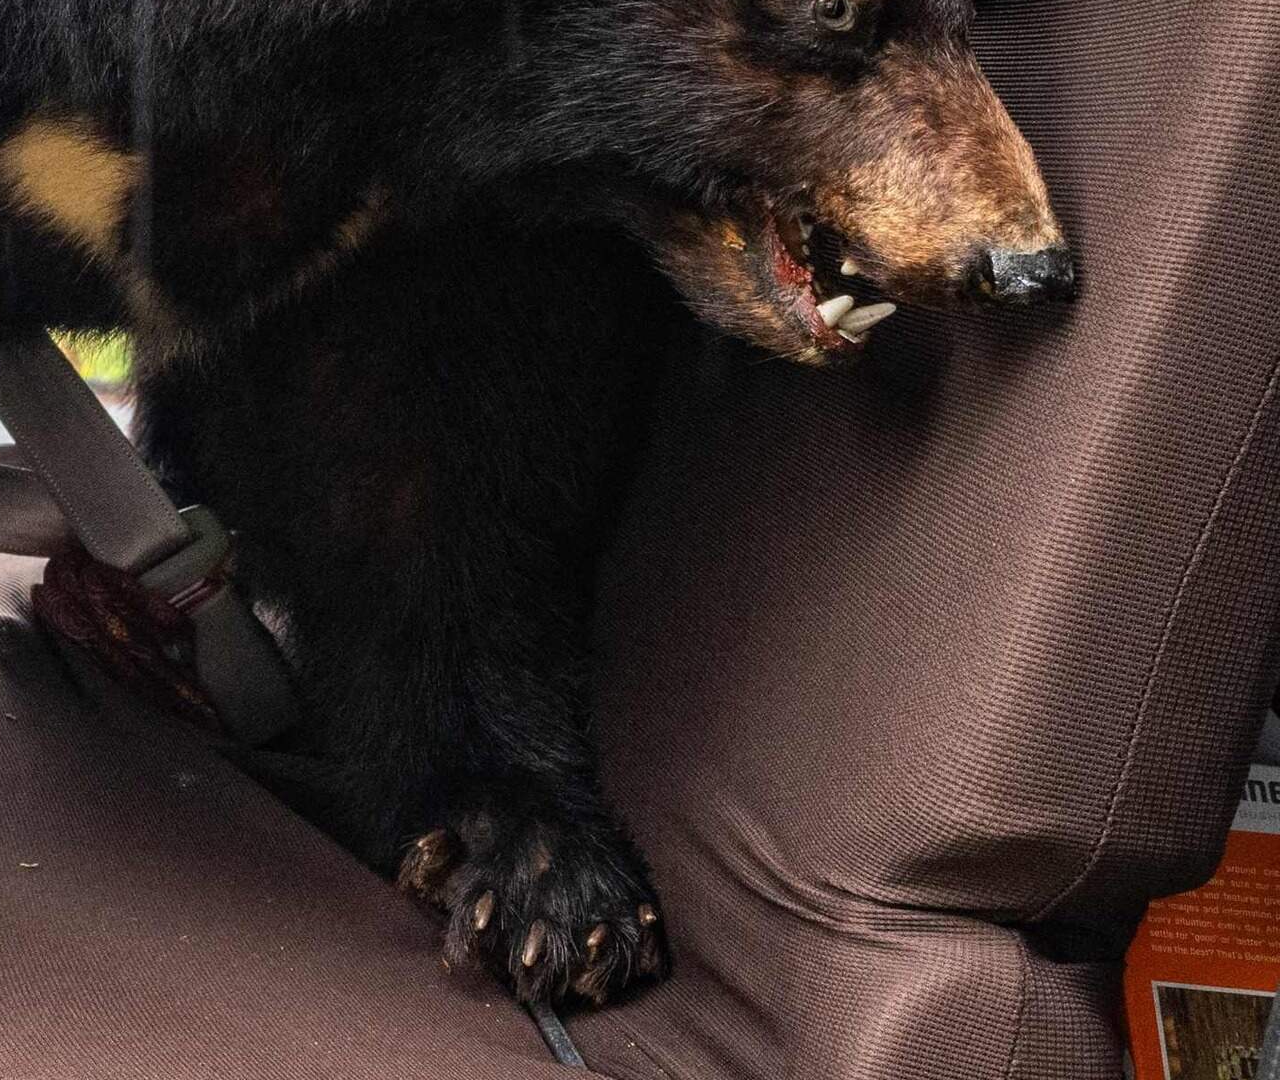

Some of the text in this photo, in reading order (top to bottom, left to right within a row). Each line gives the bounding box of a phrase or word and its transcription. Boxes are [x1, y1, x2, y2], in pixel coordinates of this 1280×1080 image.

[1223, 892, 1260, 904] features
[1203, 905, 1220, 914] and
[1222, 907, 1272, 919] information
[1149, 929, 1174, 939] settle
[1175, 931, 1189, 940] for
